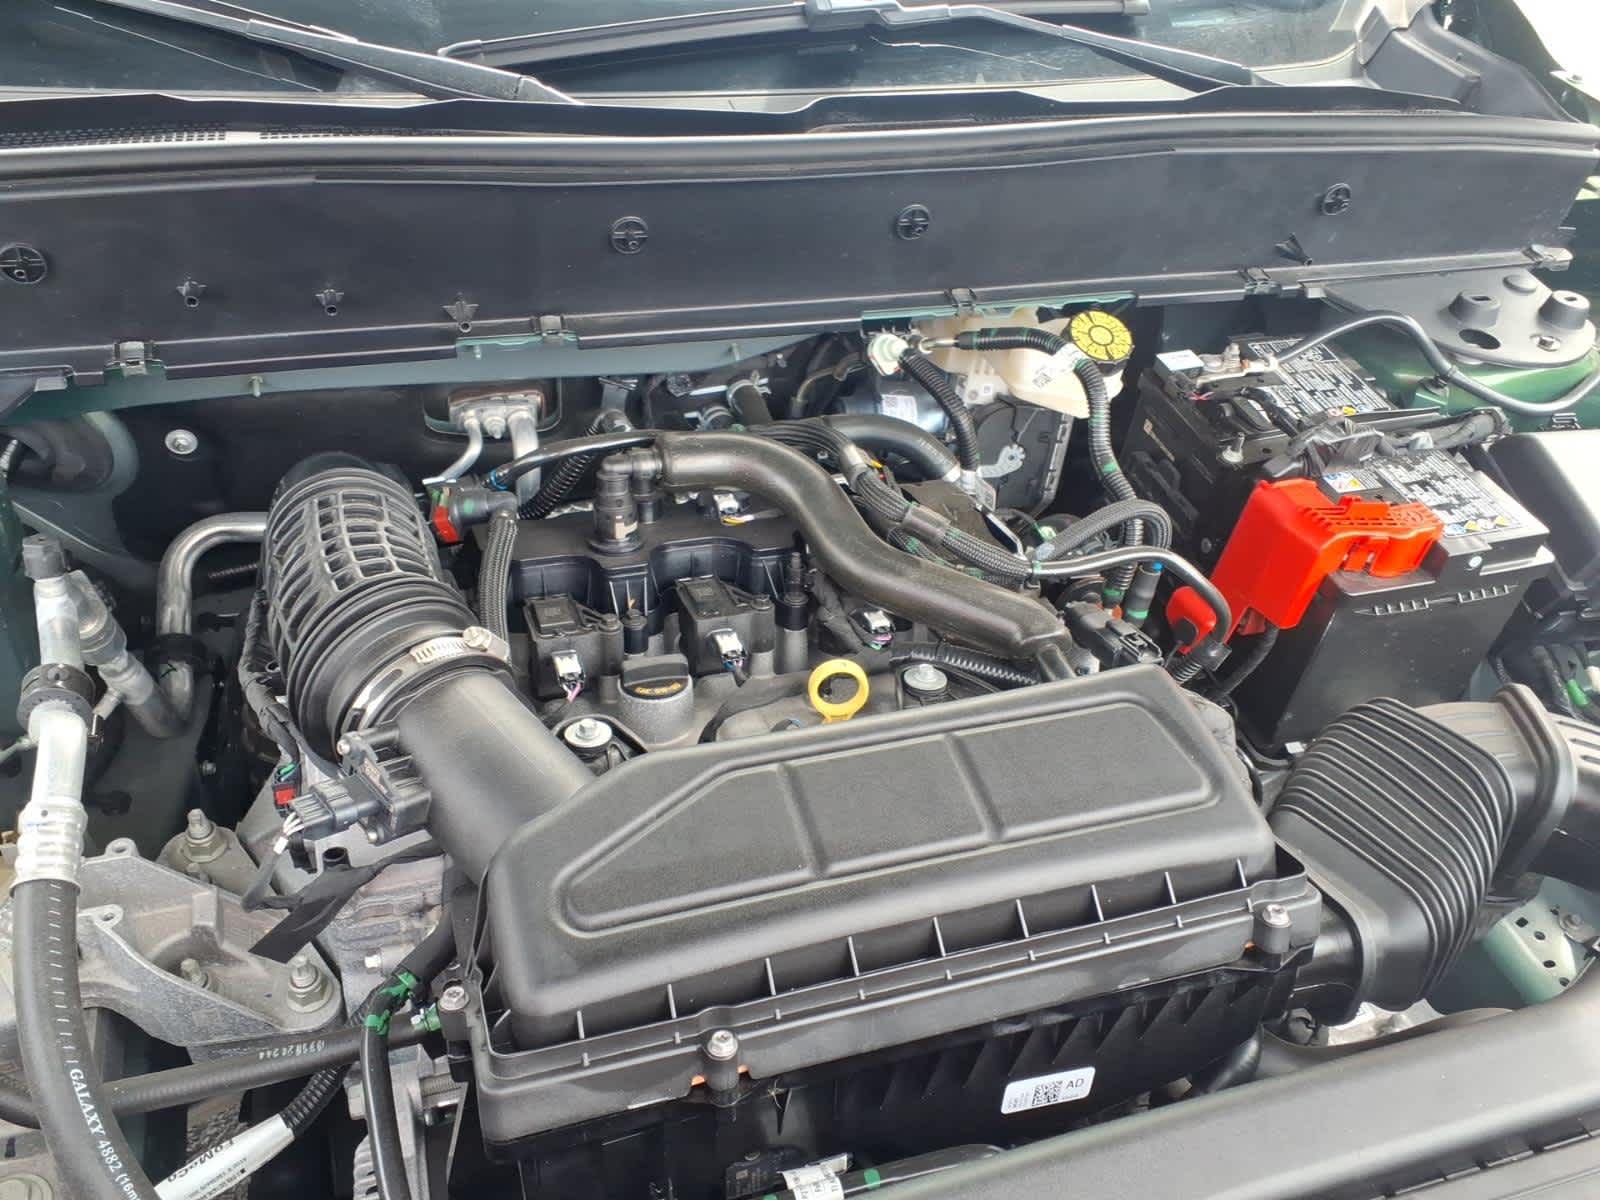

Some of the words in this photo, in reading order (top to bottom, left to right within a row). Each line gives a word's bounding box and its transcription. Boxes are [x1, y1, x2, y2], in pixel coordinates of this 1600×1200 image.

[1065, 1078, 1085, 1089] AD
[69, 1068, 106, 1136] GALAXY
[98, 1139, 123, 1173] 4882
